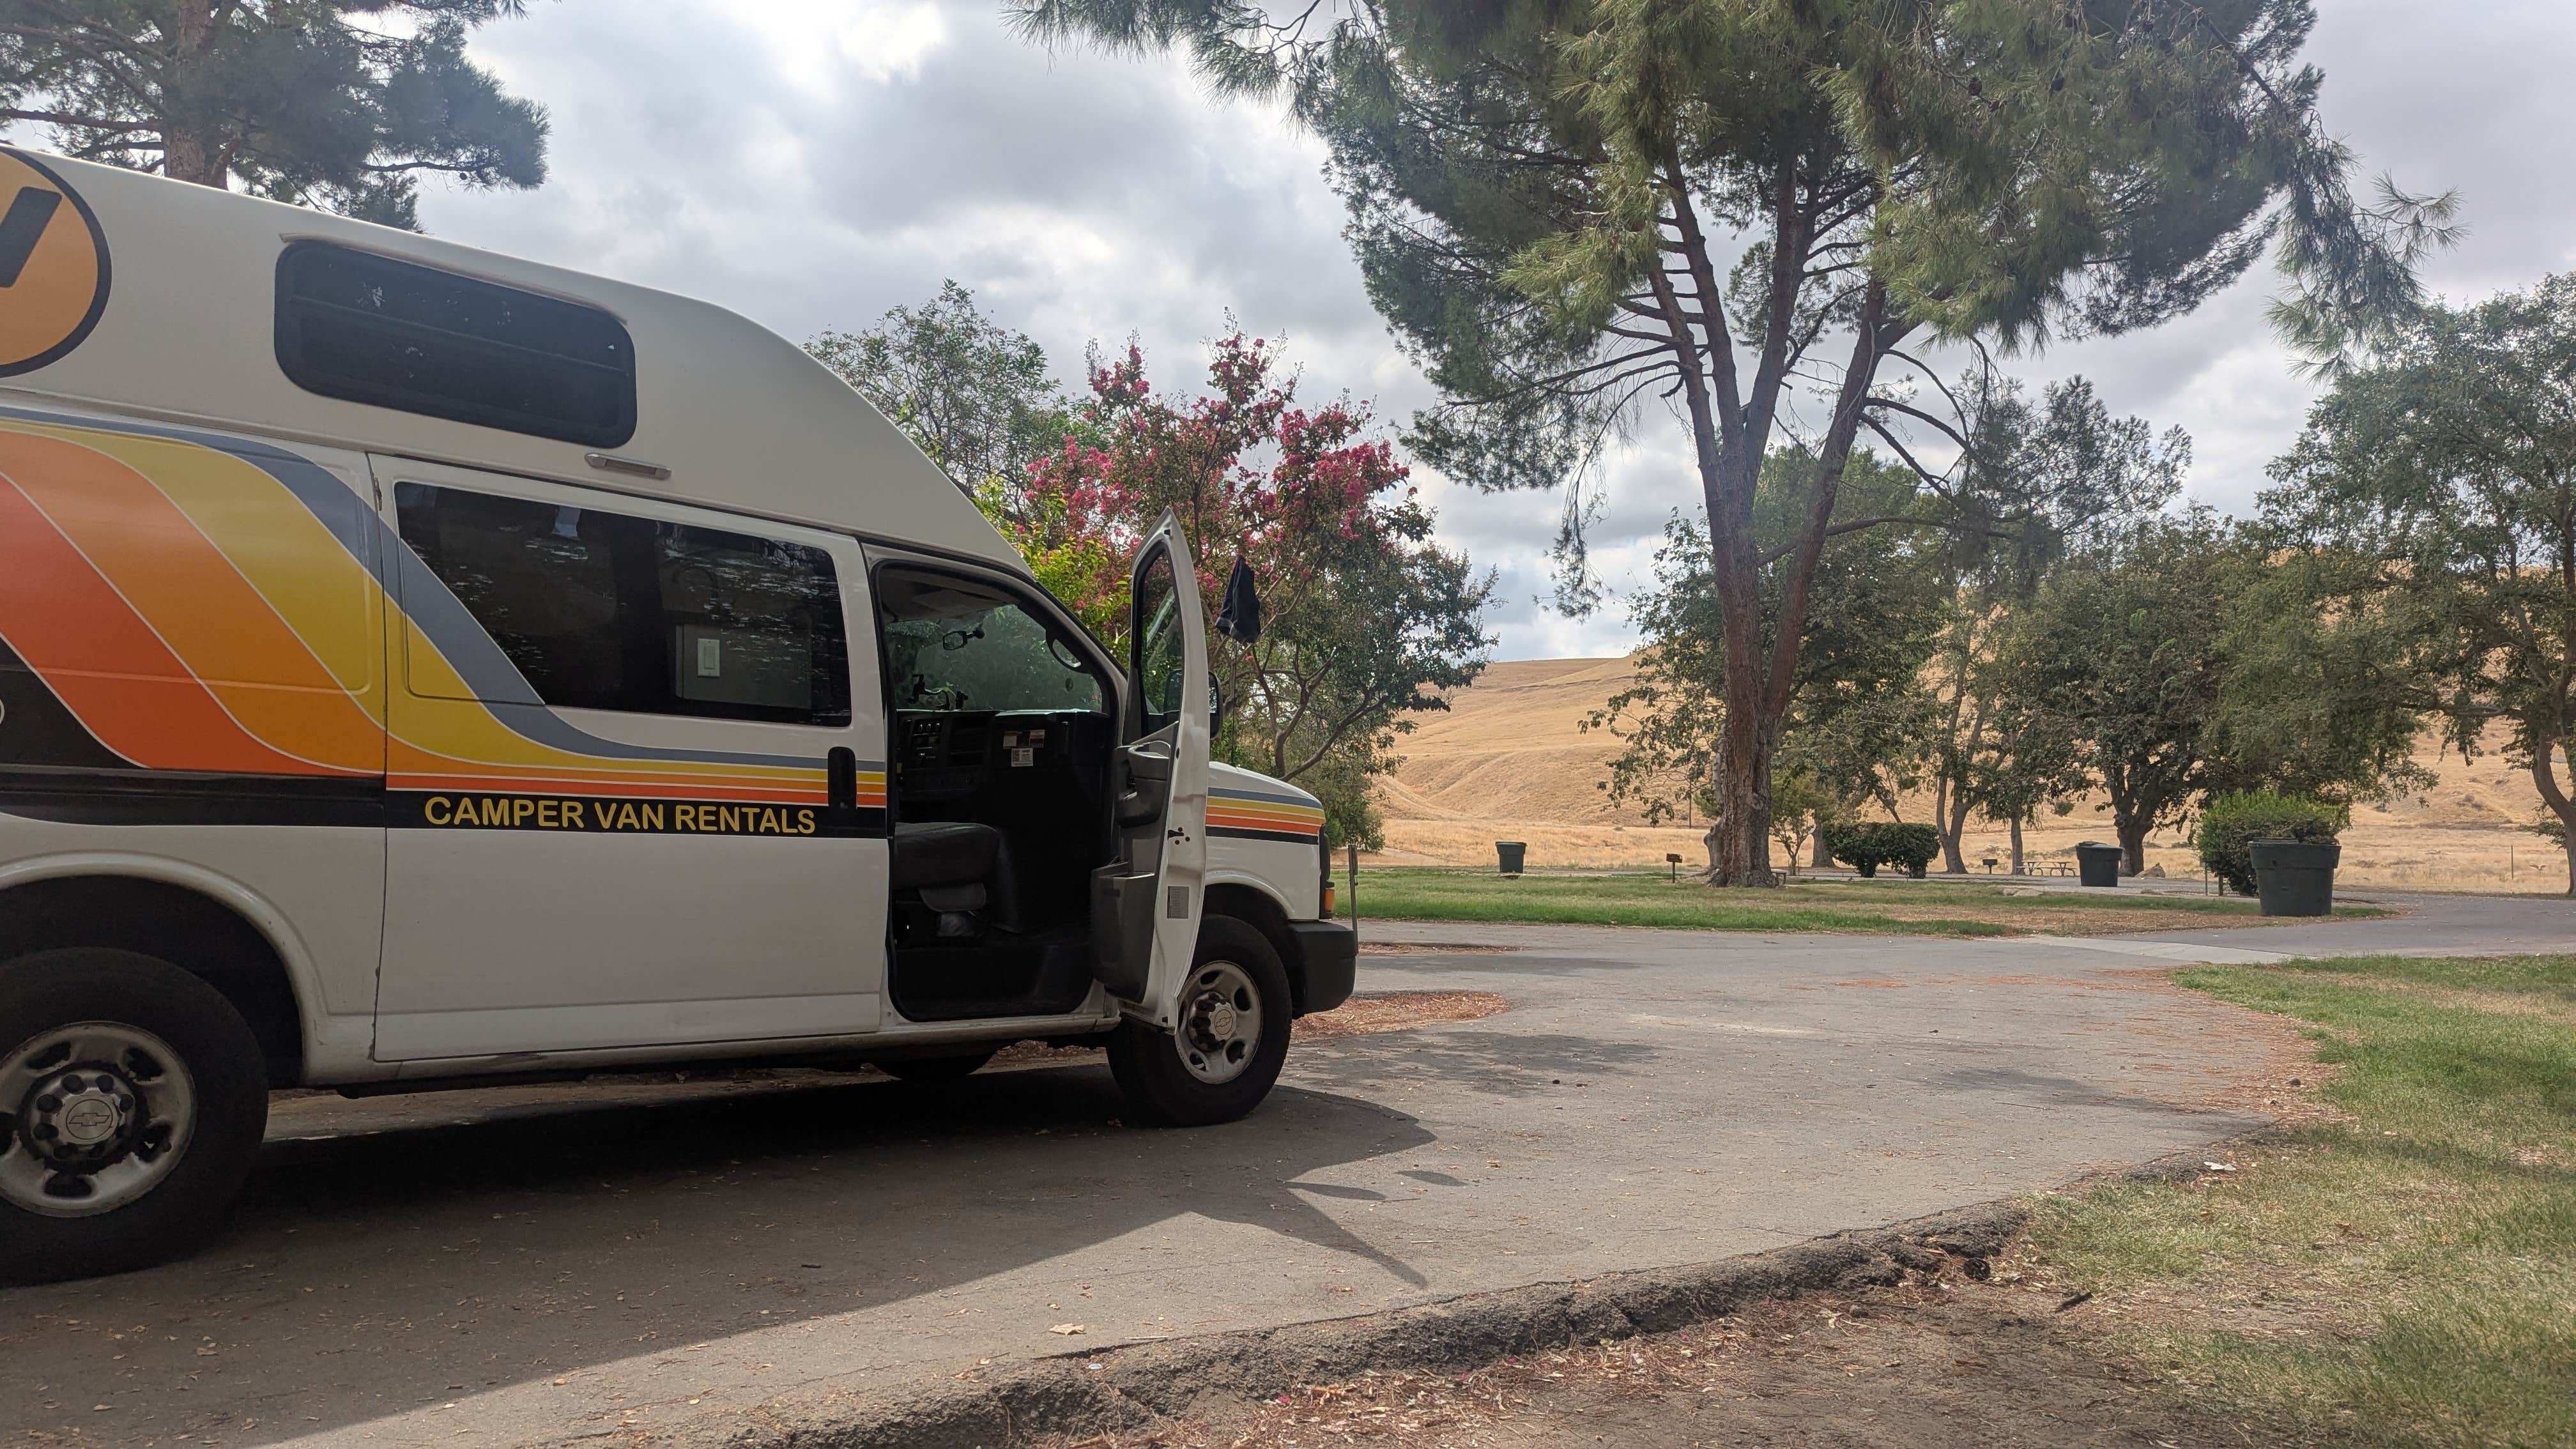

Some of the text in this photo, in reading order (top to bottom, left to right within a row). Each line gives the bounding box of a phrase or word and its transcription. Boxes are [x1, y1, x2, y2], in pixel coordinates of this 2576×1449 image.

[424, 796, 815, 834] CAMPER VAN RENTALS
